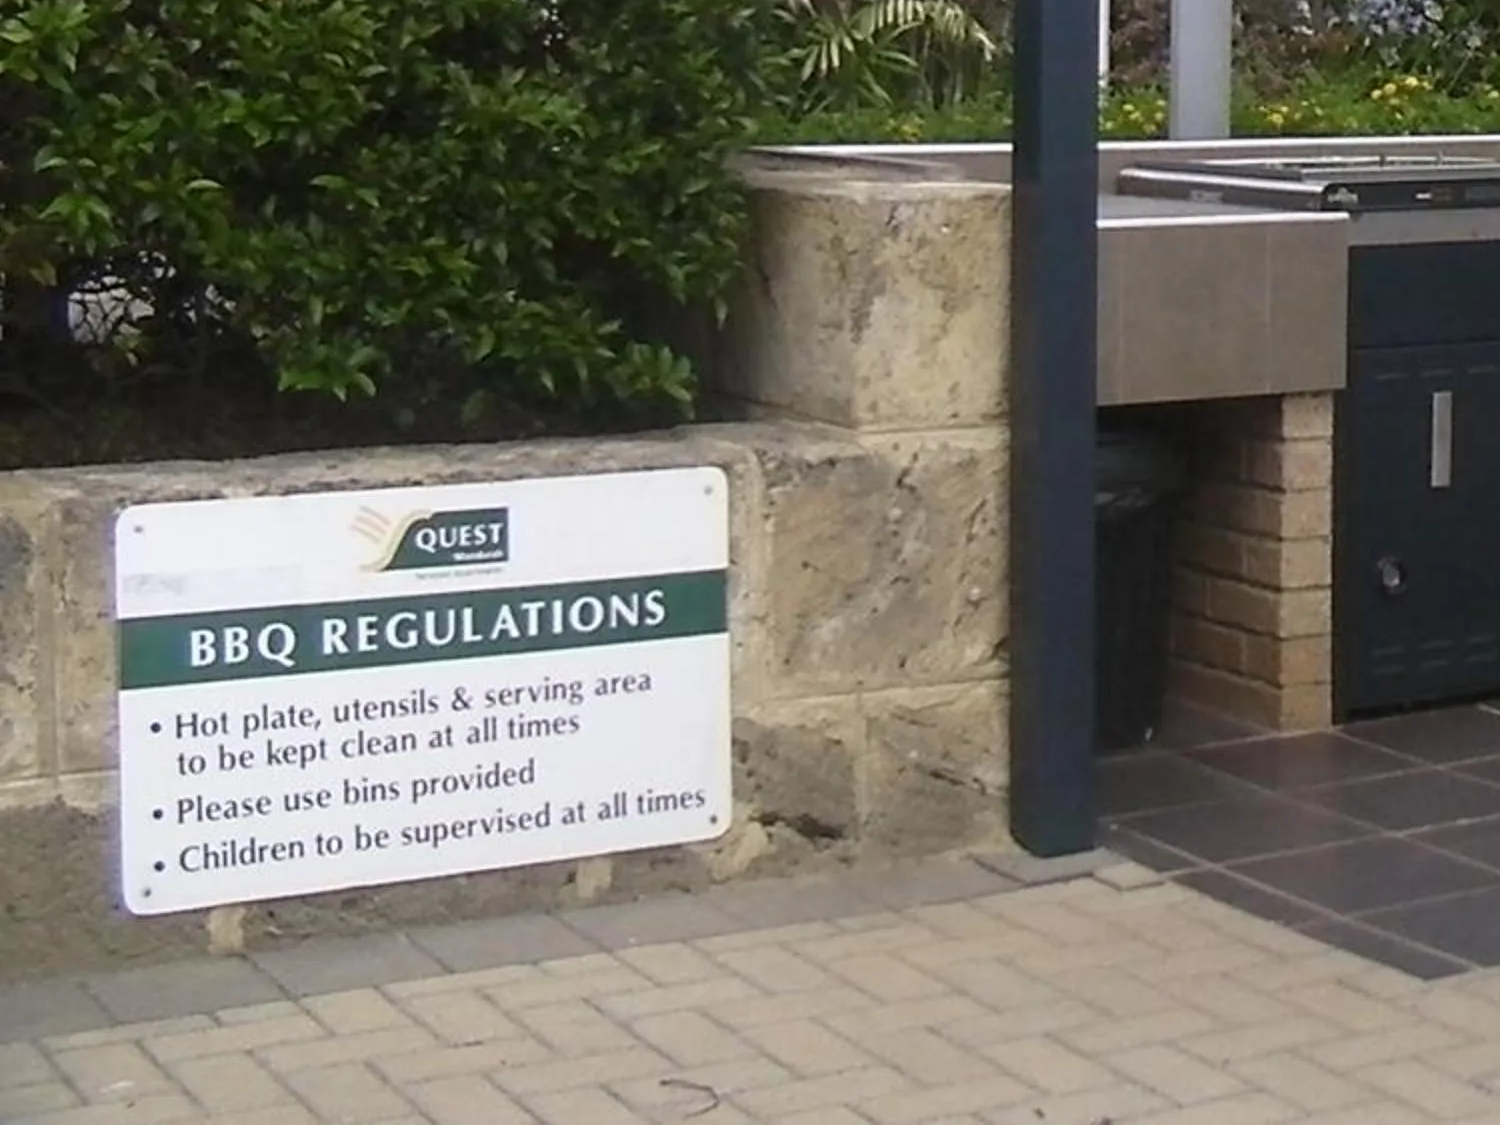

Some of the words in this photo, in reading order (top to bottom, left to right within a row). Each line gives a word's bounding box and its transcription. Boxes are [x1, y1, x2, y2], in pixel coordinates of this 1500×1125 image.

[414, 522, 504, 554] QUEST
[189, 621, 297, 668] BBQ
[321, 588, 667, 656] REGULATIONS
[175, 711, 229, 740] Hot
[243, 703, 322, 739] plate,
[333, 688, 440, 724] utensils
[450, 686, 473, 712] &
[484, 676, 584, 709] serving
[594, 672, 652, 697] area
[176, 752, 207, 776] to
[217, 743, 255, 772] be
[266, 737, 329, 770] kept
[340, 729, 418, 759] clean
[427, 724, 454, 749] at
[465, 716, 498, 746] all
[507, 712, 581, 742] times
[177, 794, 272, 825] Please
[283, 788, 333, 813] use
[343, 777, 401, 806] bins
[411, 757, 536, 804] provided
[178, 836, 305, 874] Children
[315, 832, 344, 857] to
[354, 824, 390, 852] be
[400, 801, 551, 849] supervised
[560, 801, 587, 826] at
[597, 791, 629, 821] all
[636, 788, 707, 817] times
